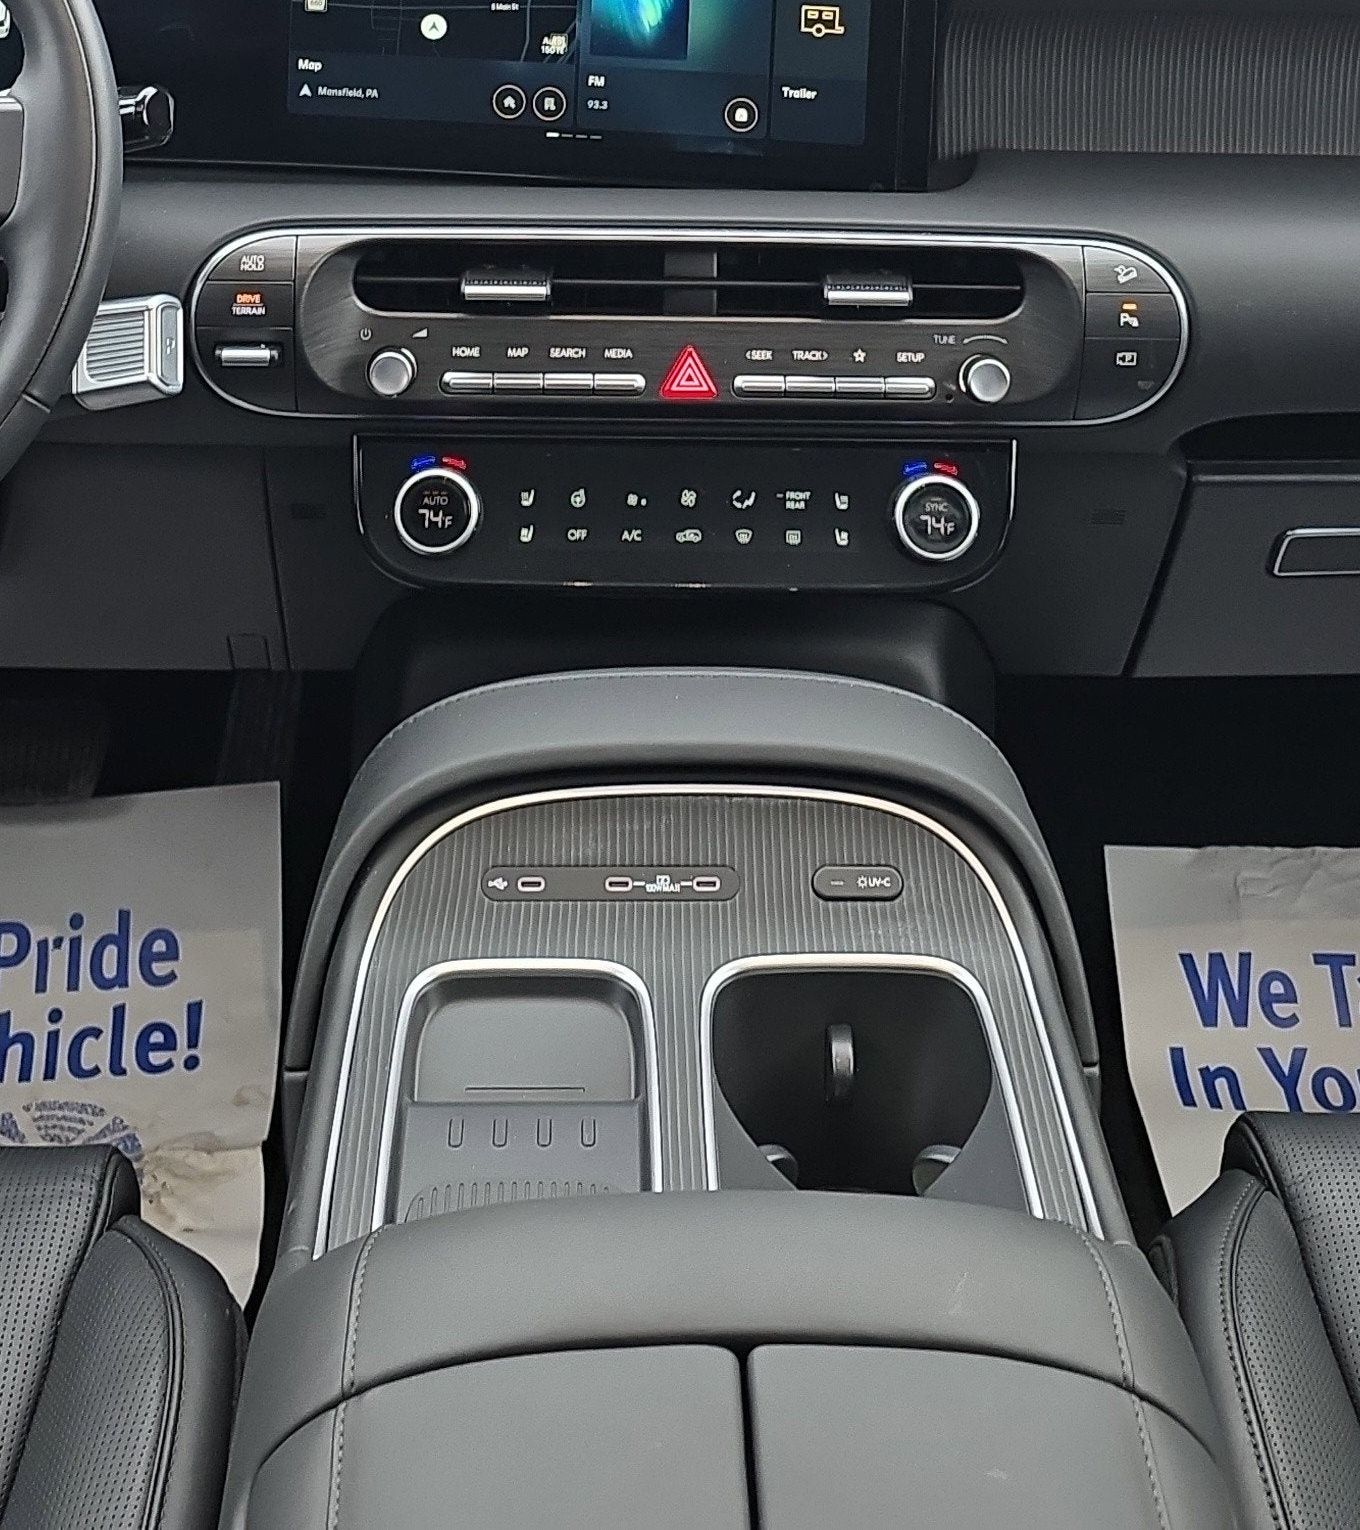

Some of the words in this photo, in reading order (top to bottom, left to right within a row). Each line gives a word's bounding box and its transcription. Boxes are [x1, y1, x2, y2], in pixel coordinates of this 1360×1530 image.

[298, 58, 322, 72] Map
[588, 75, 605, 87] FM
[318, 86, 365, 99] Mansfield,
[366, 88, 379, 99] PA
[782, 86, 817, 100] Trailer
[241, 255, 265, 263] AUTO
[240, 262, 265, 271] HOLD
[236, 294, 261, 303] DRIVE
[232, 306, 266, 315] TERRAIN
[933, 335, 956, 345] TUNE
[452, 346, 481, 358] HOME
[507, 347, 529, 358] MAP
[549, 347, 586, 358] SEARCH
[604, 348, 633, 359] MEDIA
[897, 352, 925, 363] SETUP
[422, 496, 449, 506] AUTO
[785, 491, 810, 501] FRONT
[785, 500, 805, 510] REAR
[925, 502, 948, 512] SYNC
[567, 529, 587, 541] OFF
[621, 529, 642, 541] A/C
[868, 876, 891, 887] UV-C
[1178, 951, 1299, 1030] We
[1169, 1046, 1242, 1111] In
